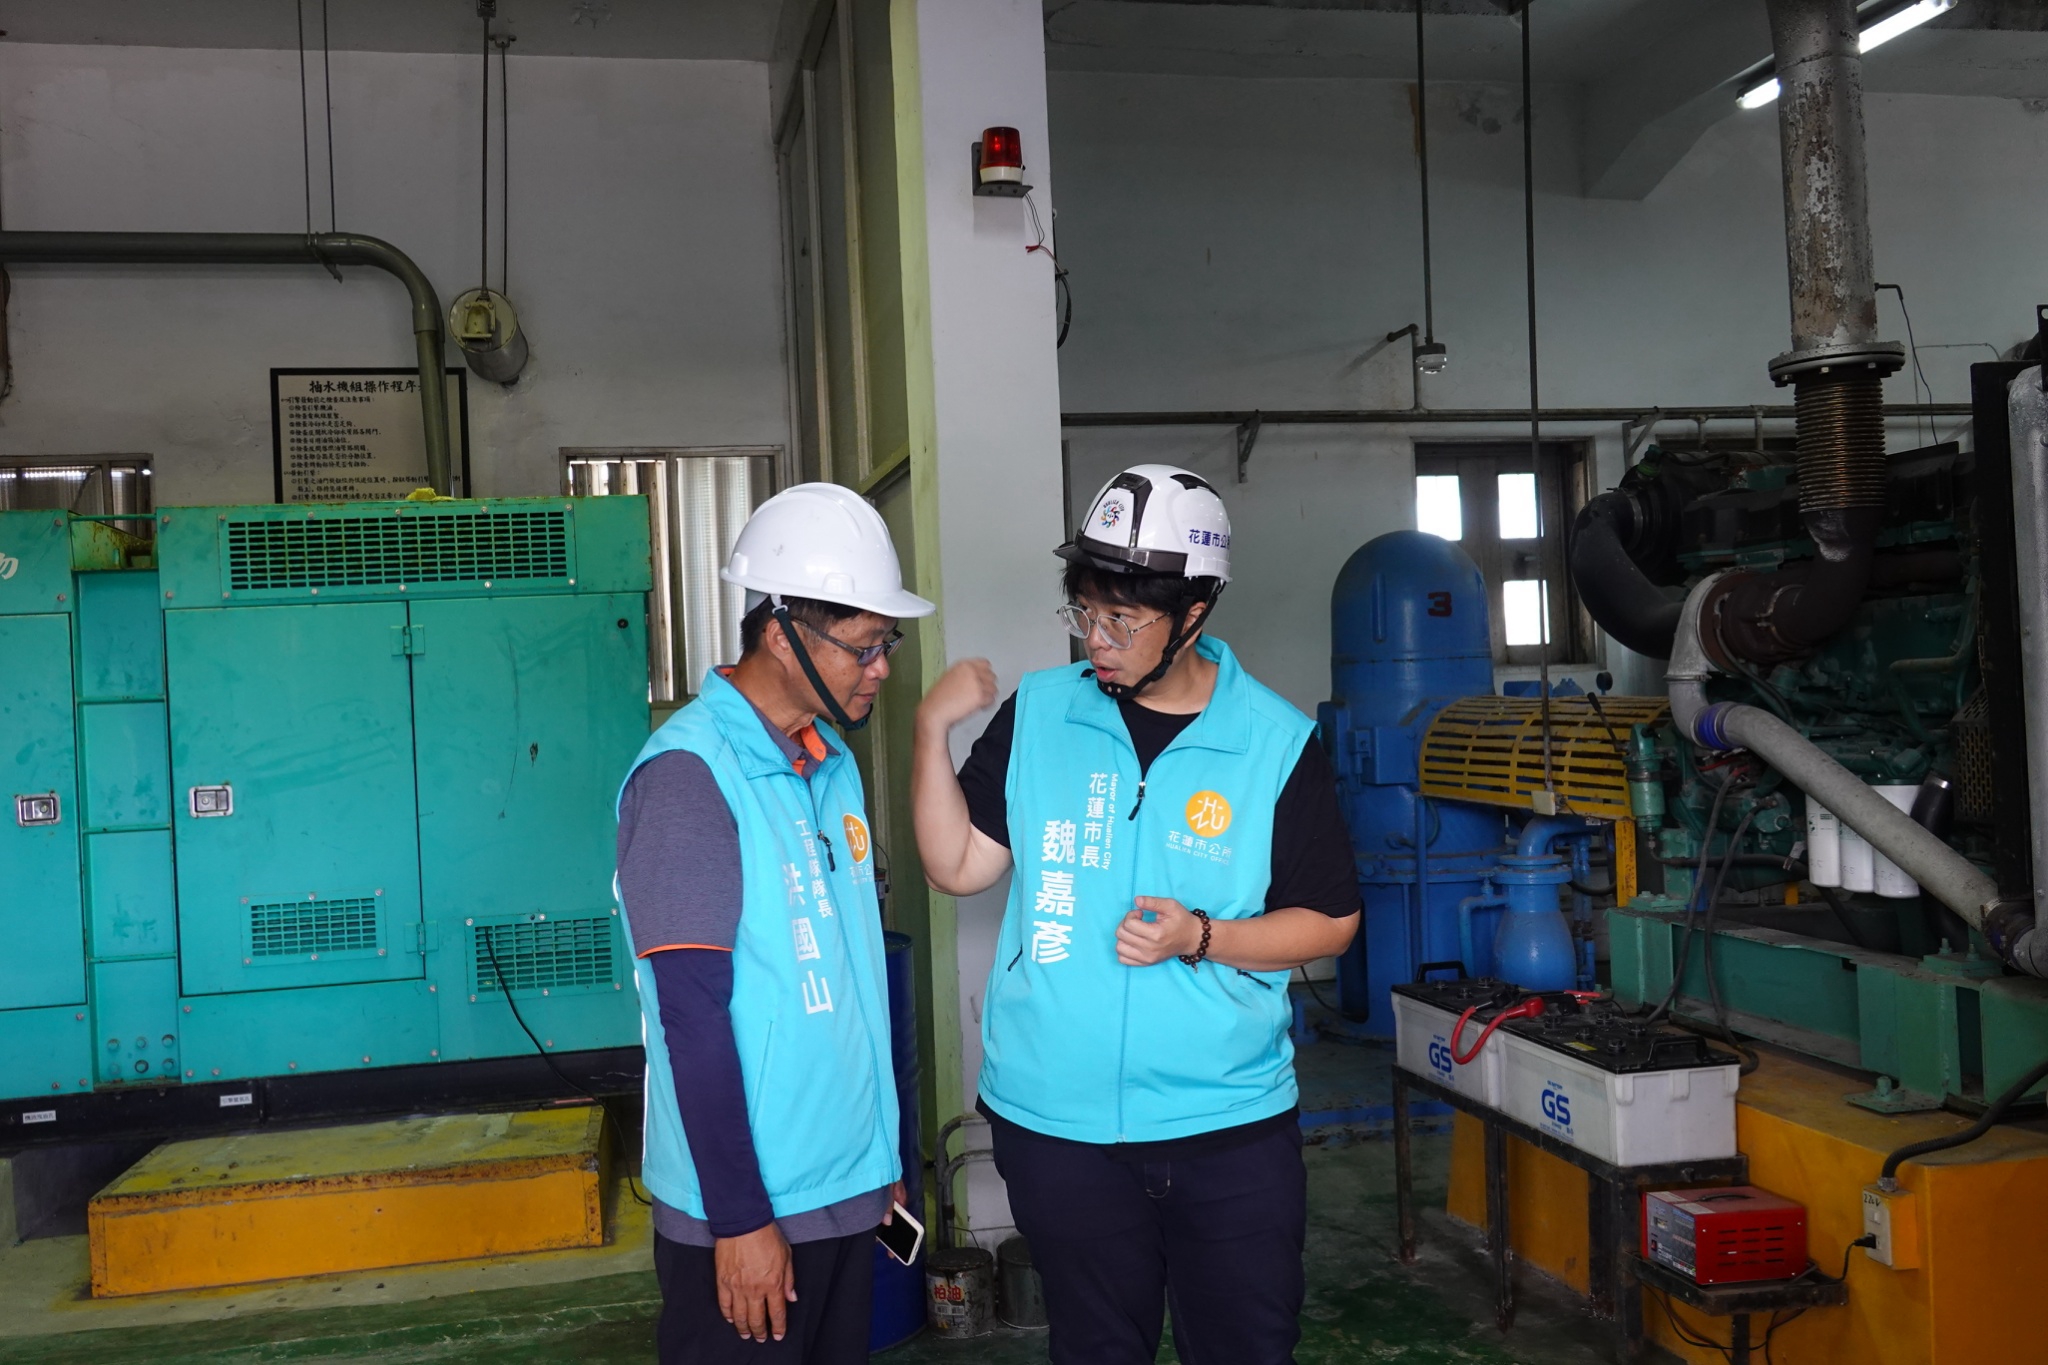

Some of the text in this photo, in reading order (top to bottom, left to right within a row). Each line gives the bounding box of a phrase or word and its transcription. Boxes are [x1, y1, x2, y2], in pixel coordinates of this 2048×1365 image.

[309, 380, 421, 393] 抽水機組操作程序
[1427, 591, 1452, 617] 3
[1081, 772, 1109, 869] 花蓮市長
[1101, 773, 1119, 871] Mayor of Hualien City
[1168, 830, 1232, 858] 花蓮市公所
[1428, 1042, 1452, 1073] GS
[1541, 1089, 1571, 1126] GS
[933, 1284, 963, 1301] 柏油
